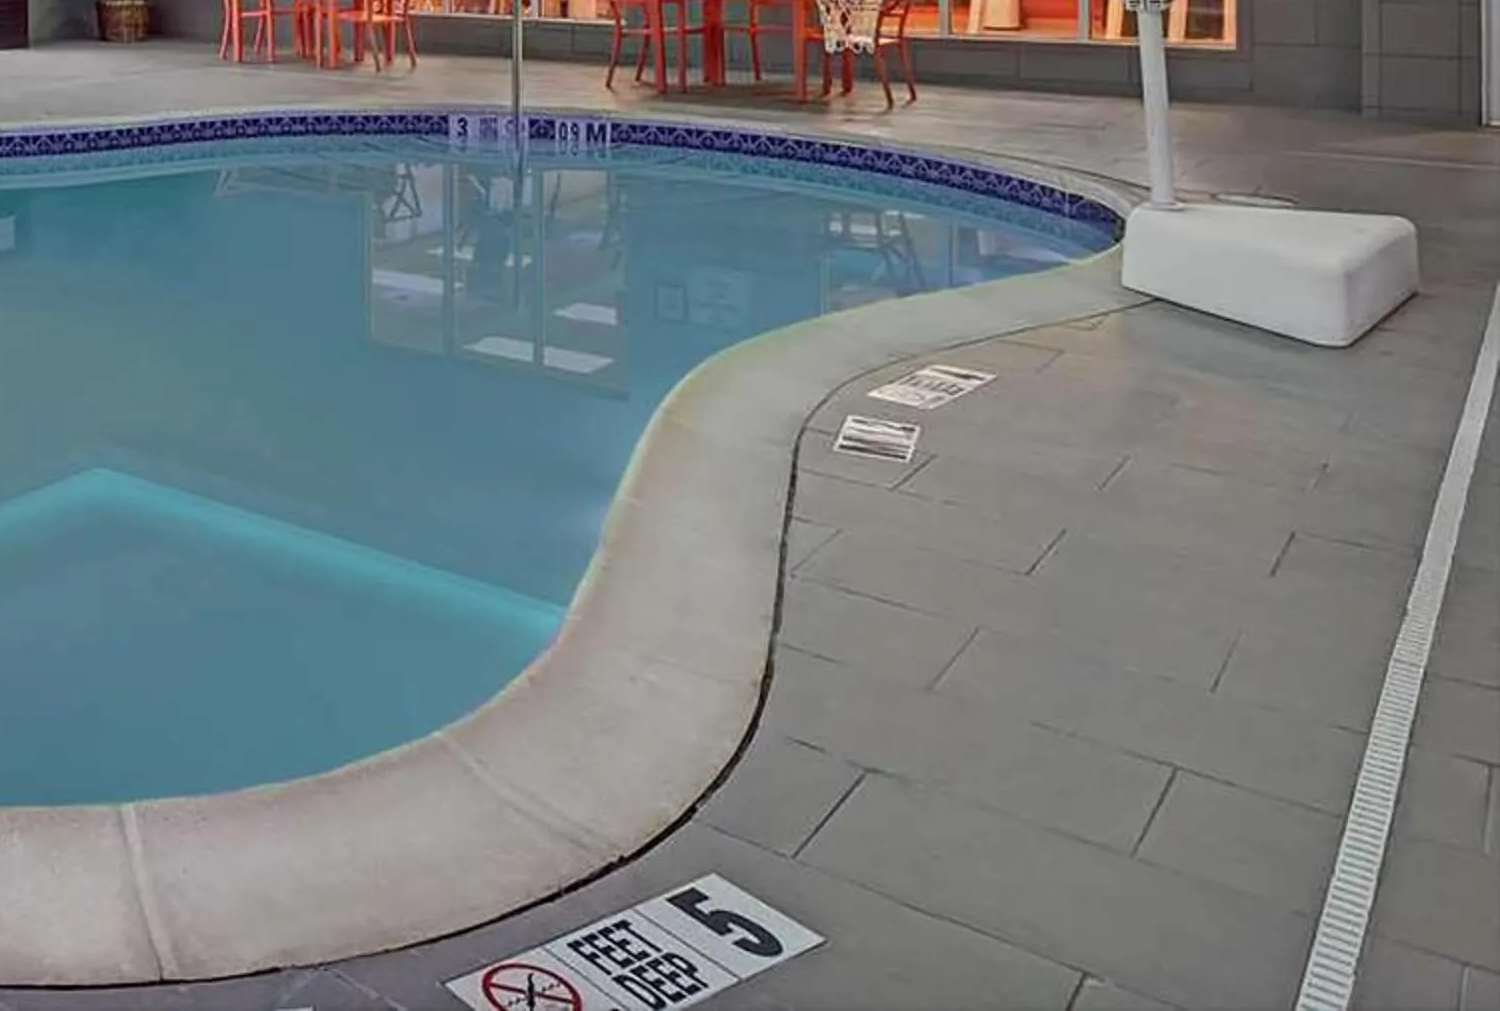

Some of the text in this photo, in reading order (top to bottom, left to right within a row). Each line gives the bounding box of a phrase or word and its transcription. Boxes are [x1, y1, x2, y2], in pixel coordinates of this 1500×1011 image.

[566, 919, 663, 976] FEET
[665, 887, 784, 957] 5
[611, 952, 709, 1011] DEEP
